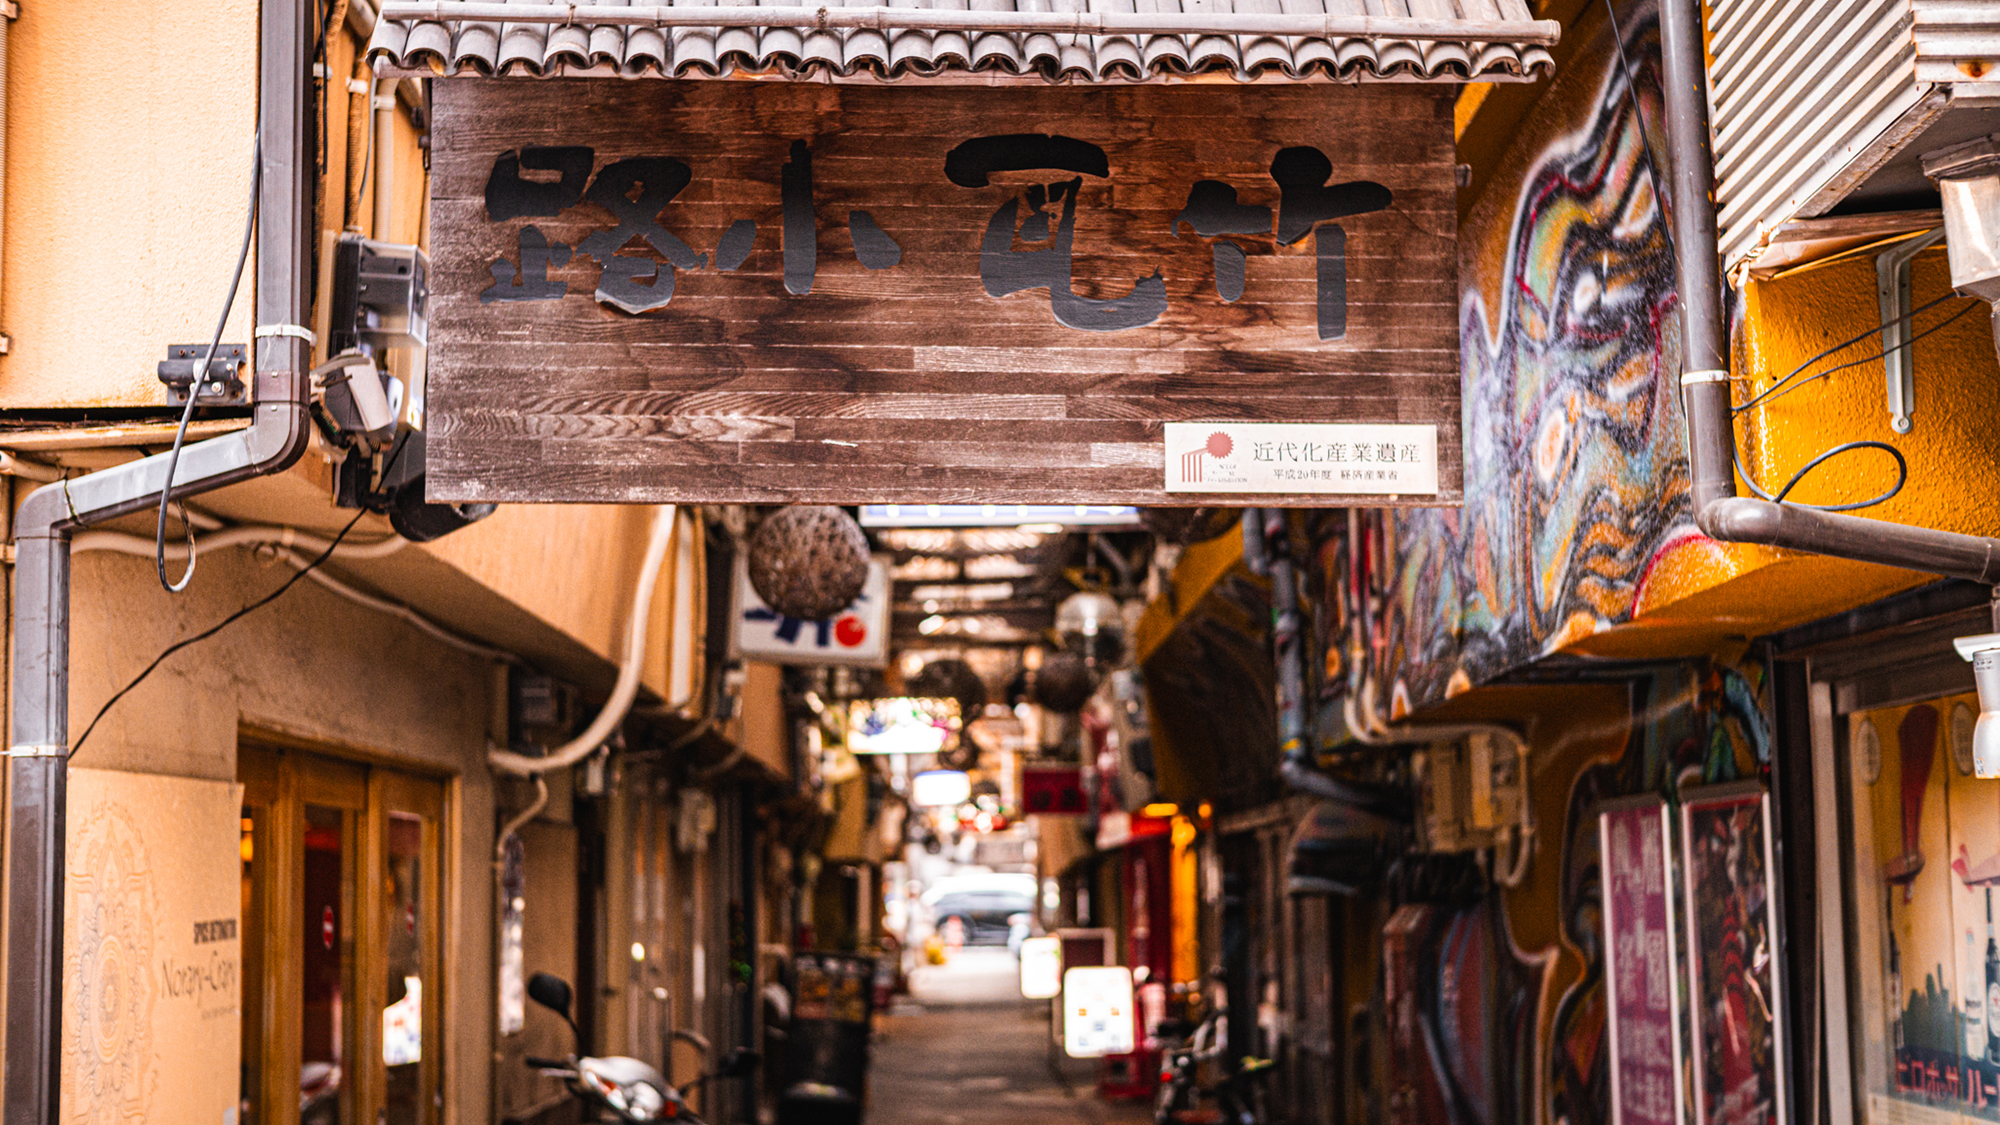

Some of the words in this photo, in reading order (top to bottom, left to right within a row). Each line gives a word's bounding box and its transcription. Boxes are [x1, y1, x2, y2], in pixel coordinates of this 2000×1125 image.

[1253, 442, 1421, 463] 近代化産業遺産
[1273, 469, 1332, 481] 平成20年度
[1340, 469, 1398, 481] 経済産業省
